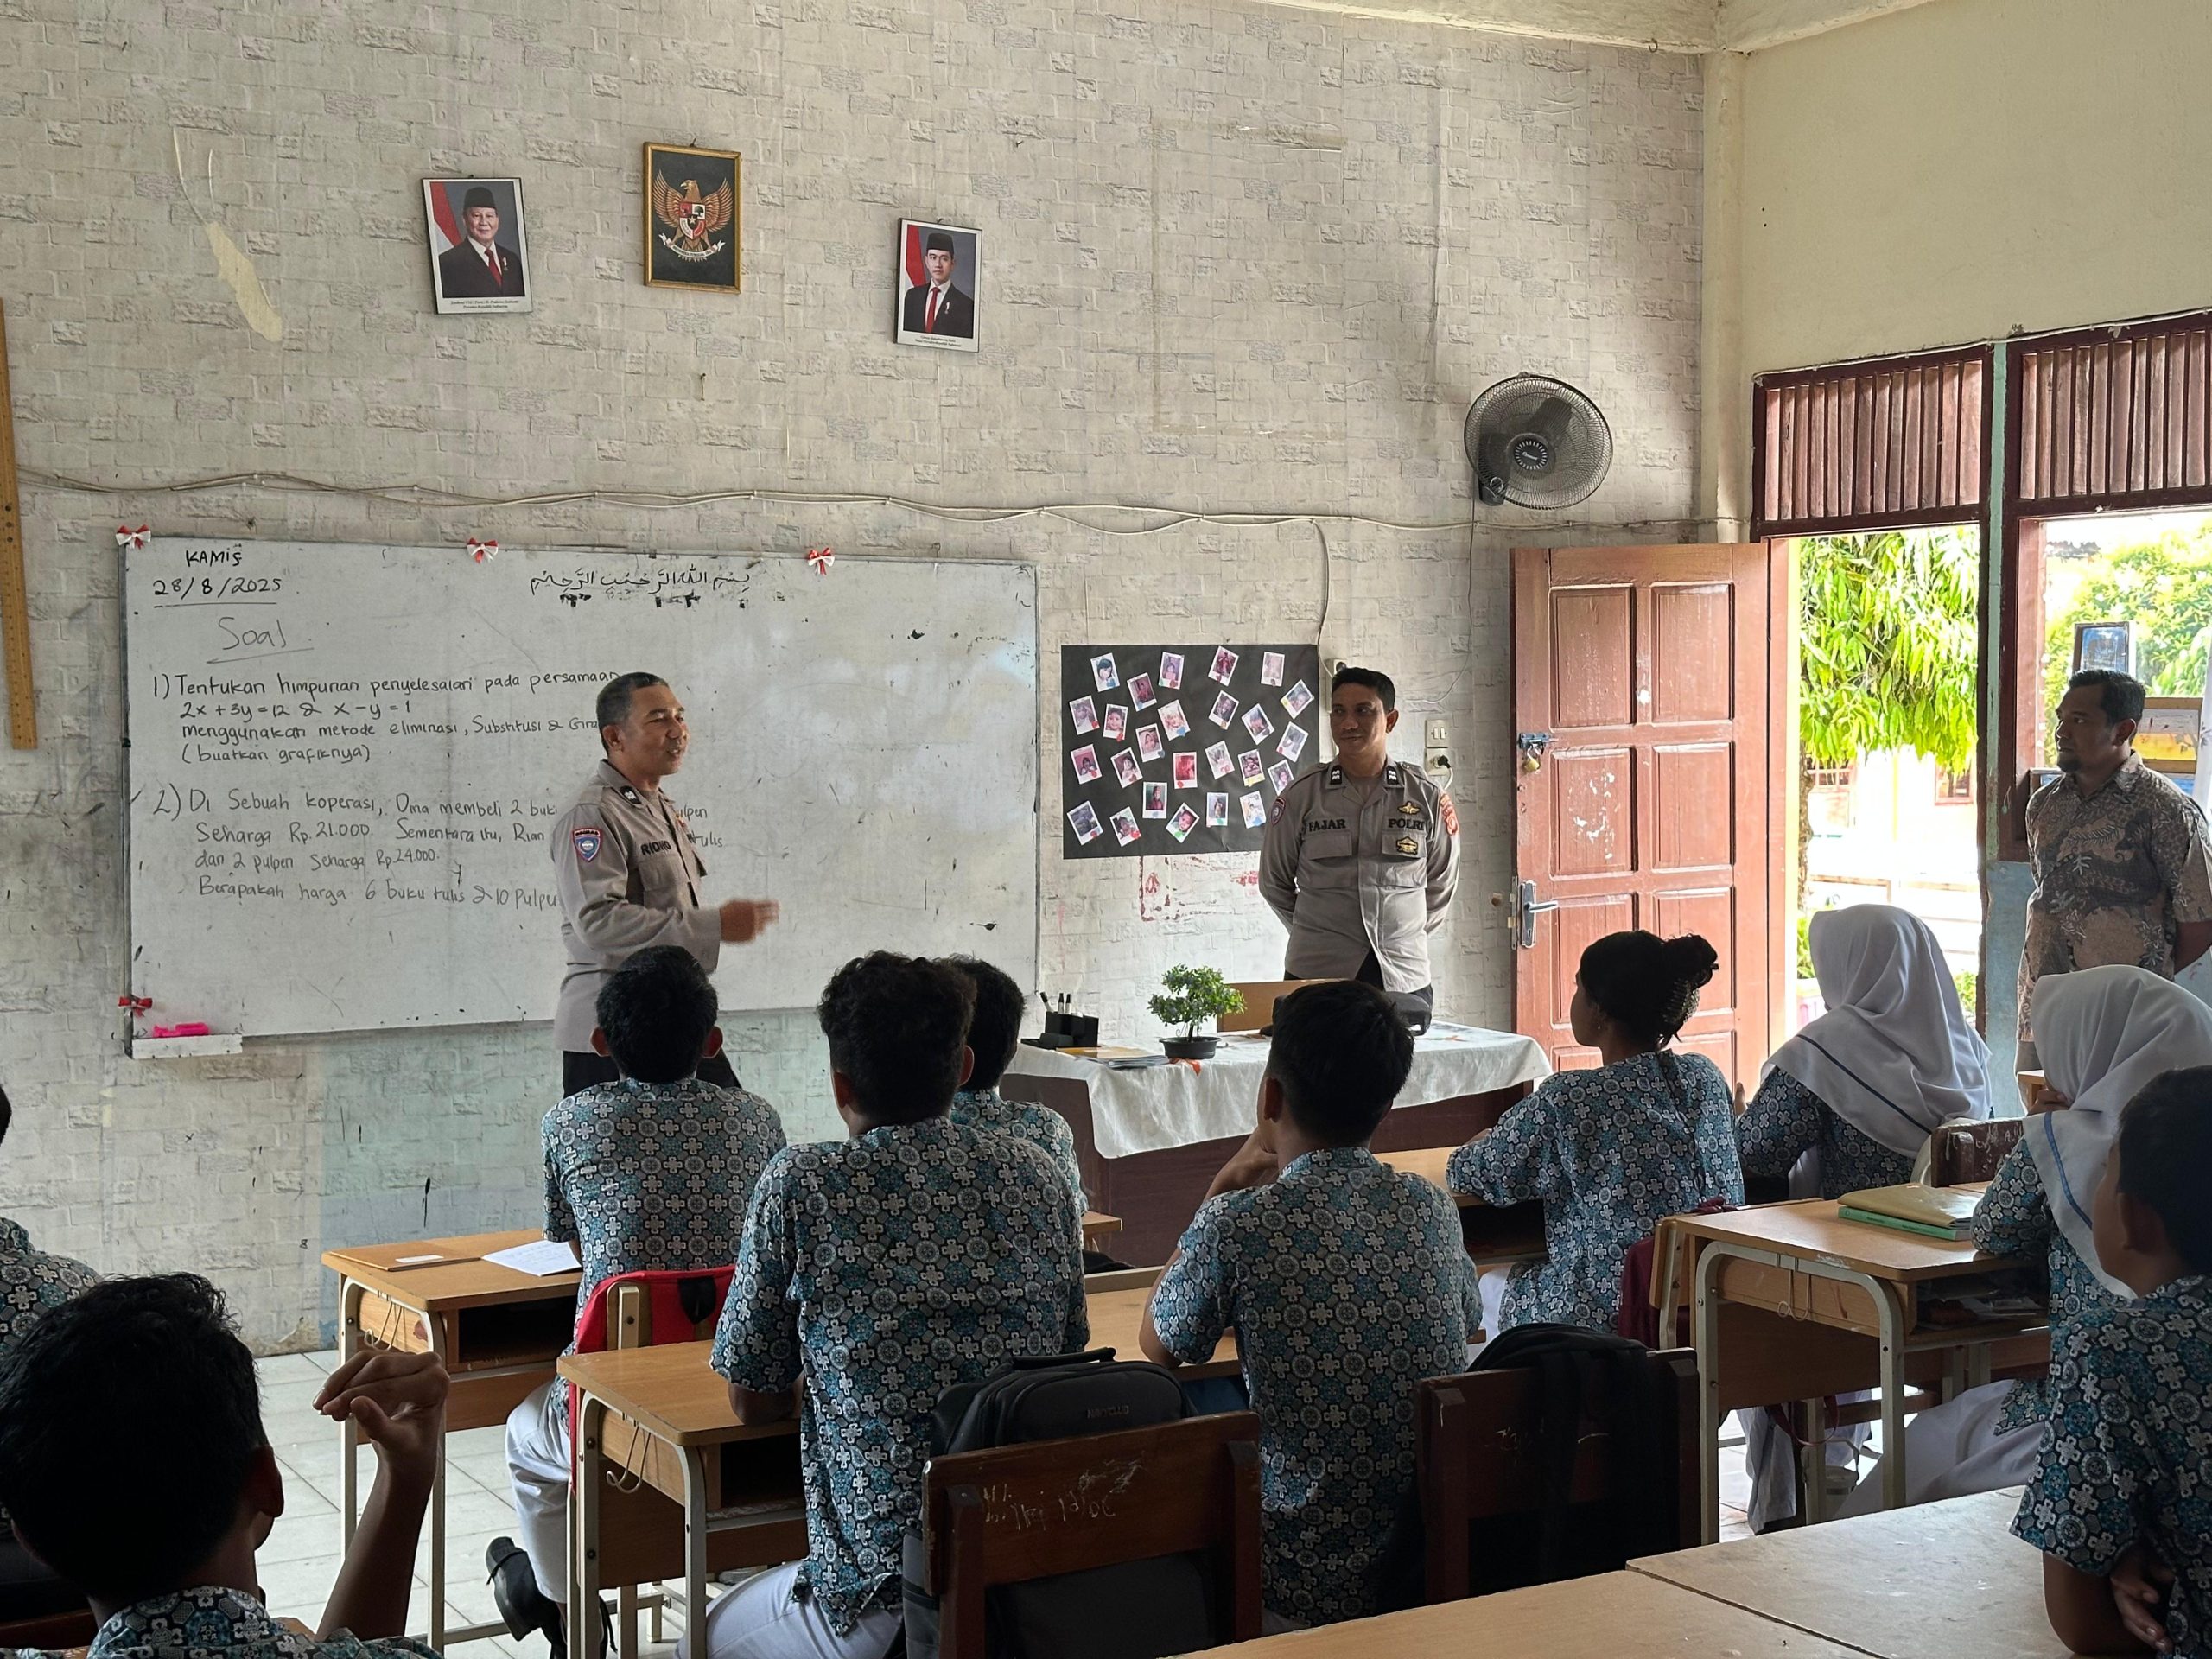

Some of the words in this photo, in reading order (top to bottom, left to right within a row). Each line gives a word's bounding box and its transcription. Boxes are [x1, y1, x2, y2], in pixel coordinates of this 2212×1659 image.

[218, 616, 288, 650] Soal
[175, 674, 265, 694] Tentukan
[276, 673, 359, 702] himpunan
[485, 674, 520, 694] pada
[182, 724, 306, 745] menggunakan
[319, 725, 375, 735] metode
[439, 800, 502, 817] membeli
[510, 799, 523, 815] 2
[512, 822, 544, 842] Rian
[1309, 819, 1346, 832] FAJAR
[1388, 818, 1425, 830] POLRI
[194, 849, 225, 868] dan
[233, 852, 246, 868] 2
[253, 855, 294, 874] pulpen
[199, 874, 284, 899] Berapakah
[299, 883, 347, 906] harga
[365, 879, 376, 899] 6
[386, 878, 425, 899] buku
[496, 888, 509, 906] 10
